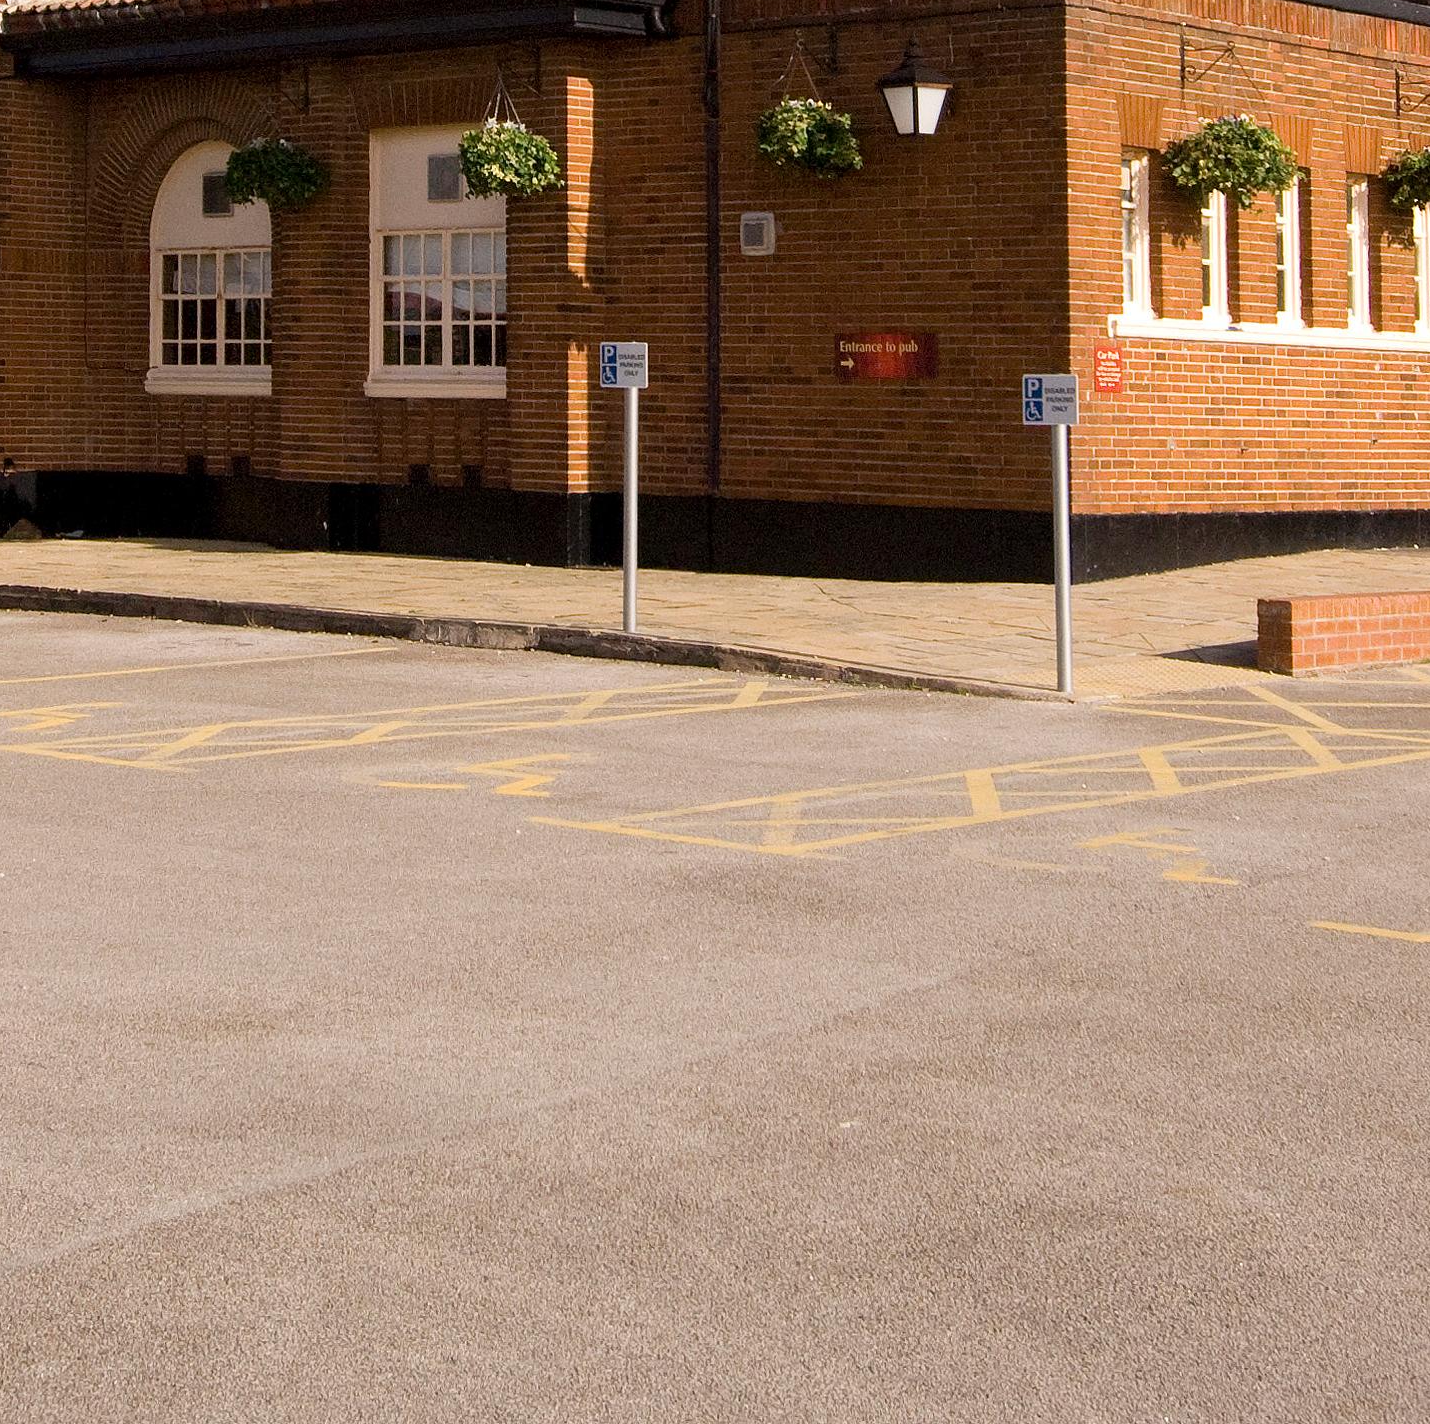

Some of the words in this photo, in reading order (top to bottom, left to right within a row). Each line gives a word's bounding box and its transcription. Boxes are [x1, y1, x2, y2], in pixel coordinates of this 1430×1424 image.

[603, 346, 615, 363] P
[839, 340, 883, 353] Entrance
[885, 341, 897, 353] to
[898, 339, 919, 357] pub
[1027, 379, 1040, 398] P
[1051, 405, 1069, 413] ONLY
